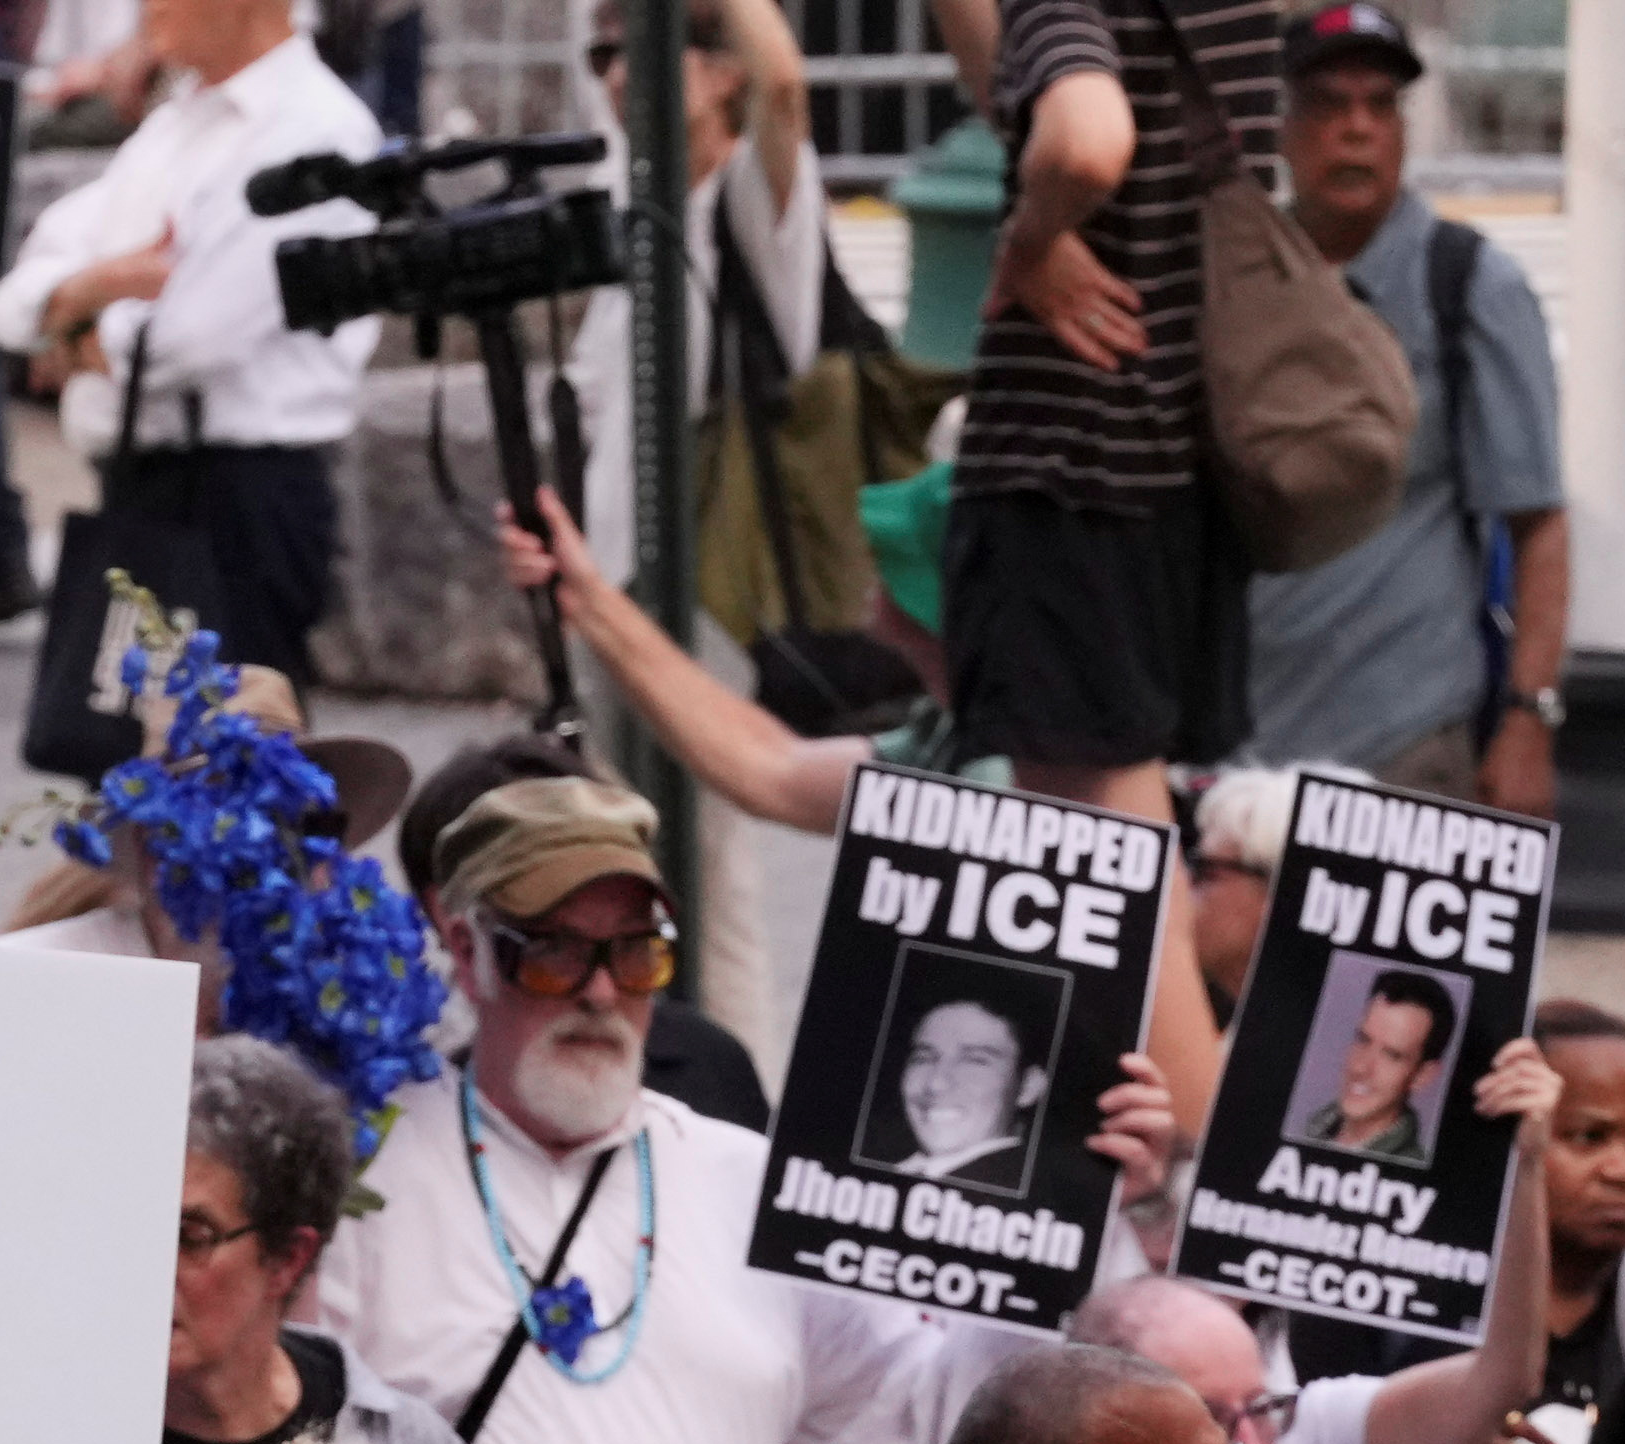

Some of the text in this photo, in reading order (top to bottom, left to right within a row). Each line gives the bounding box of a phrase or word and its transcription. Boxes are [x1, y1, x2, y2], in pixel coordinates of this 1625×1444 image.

[850, 769, 1162, 893] KIDNAPPED
[1295, 780, 1547, 896] KIDNAPPED
[858, 856, 1127, 971] by ICE
[1298, 866, 1521, 974] by ICE
[772, 1155, 1085, 1273] Jhon Chacin
[1256, 1145, 1439, 1236] Andry
